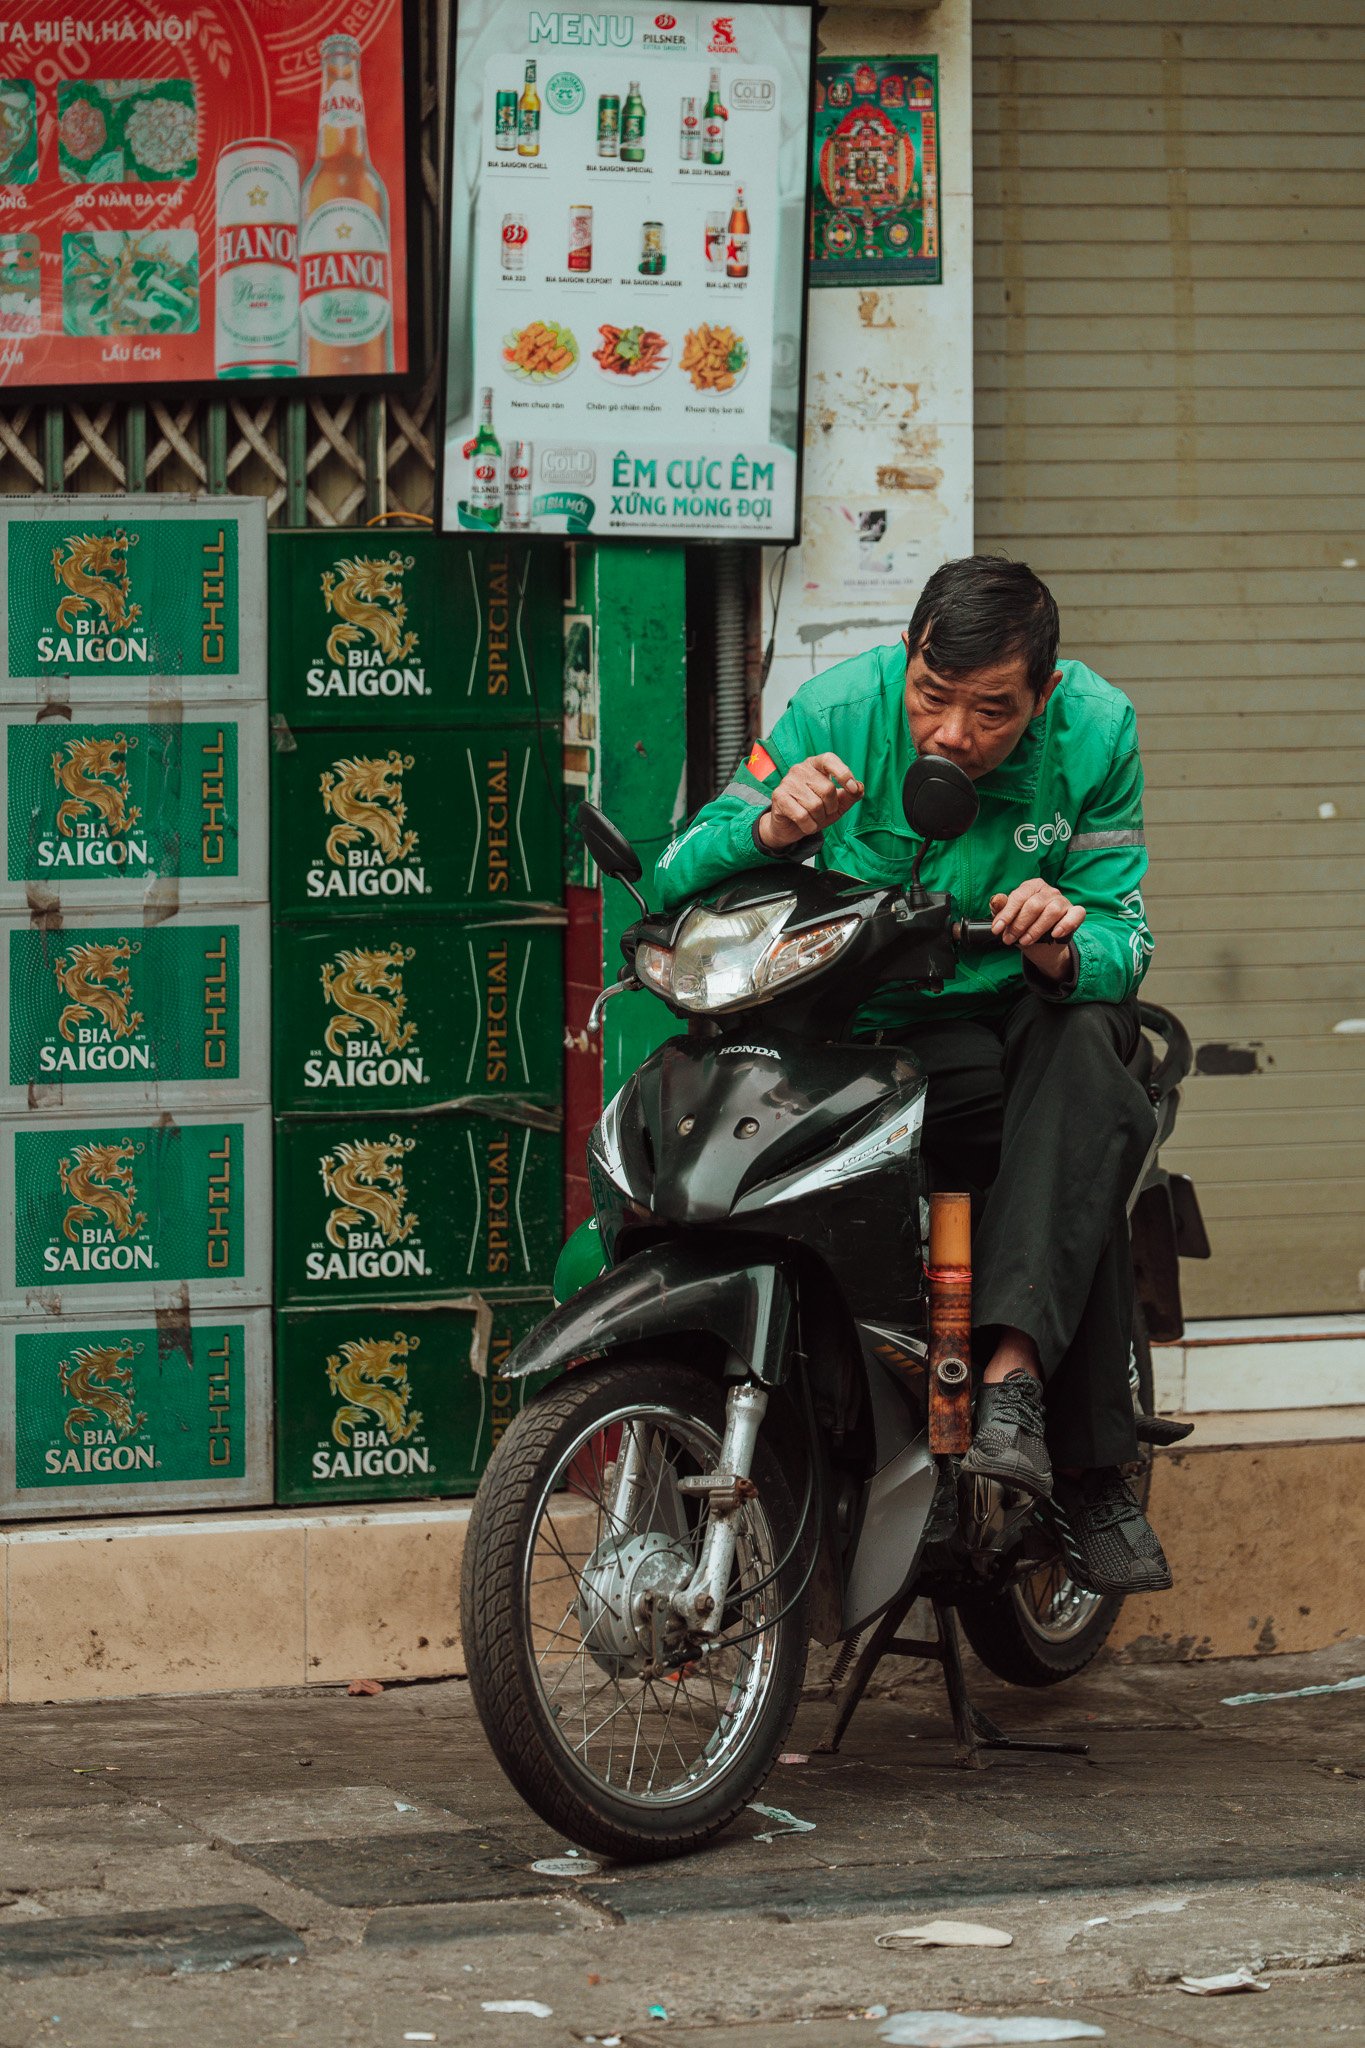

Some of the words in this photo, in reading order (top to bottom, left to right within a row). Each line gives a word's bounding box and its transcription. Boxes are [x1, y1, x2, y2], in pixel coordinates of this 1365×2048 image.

[144, 15, 192, 46] NỘI
[528, 11, 634, 47] MENU
[643, 34, 686, 44] PILSNER
[305, 254, 384, 291] HANOI
[612, 450, 657, 488] ÊM
[666, 456, 722, 494] CỰC
[731, 453, 775, 490] ÊM
[737, 498, 772, 522] ĐỢI
[203, 531, 224, 663] CHILL
[77, 620, 109, 635] BIA
[348, 650, 384, 667] BIA
[203, 731, 224, 864] CHILL
[77, 823, 109, 838] BIA
[488, 750, 509, 892] SPECIAL
[348, 850, 385, 867] BIA
[205, 936, 226, 1068] CHILL
[486, 940, 507, 1082] SPECIAL
[79, 1028, 112, 1043] BIA
[346, 1040, 383, 1058] BIA
[718, 1045, 781, 1060] HONDA
[208, 1136, 230, 1268] CHILL
[487, 1132, 509, 1272] SPECIAL
[82, 1229, 116, 1244] BIA
[348, 1232, 385, 1249] BIA
[209, 1334, 230, 1466] CHILL
[491, 1328, 512, 1447] PECIAL
[83, 1429, 117, 1445] BIA
[353, 1430, 390, 1448] BIA
